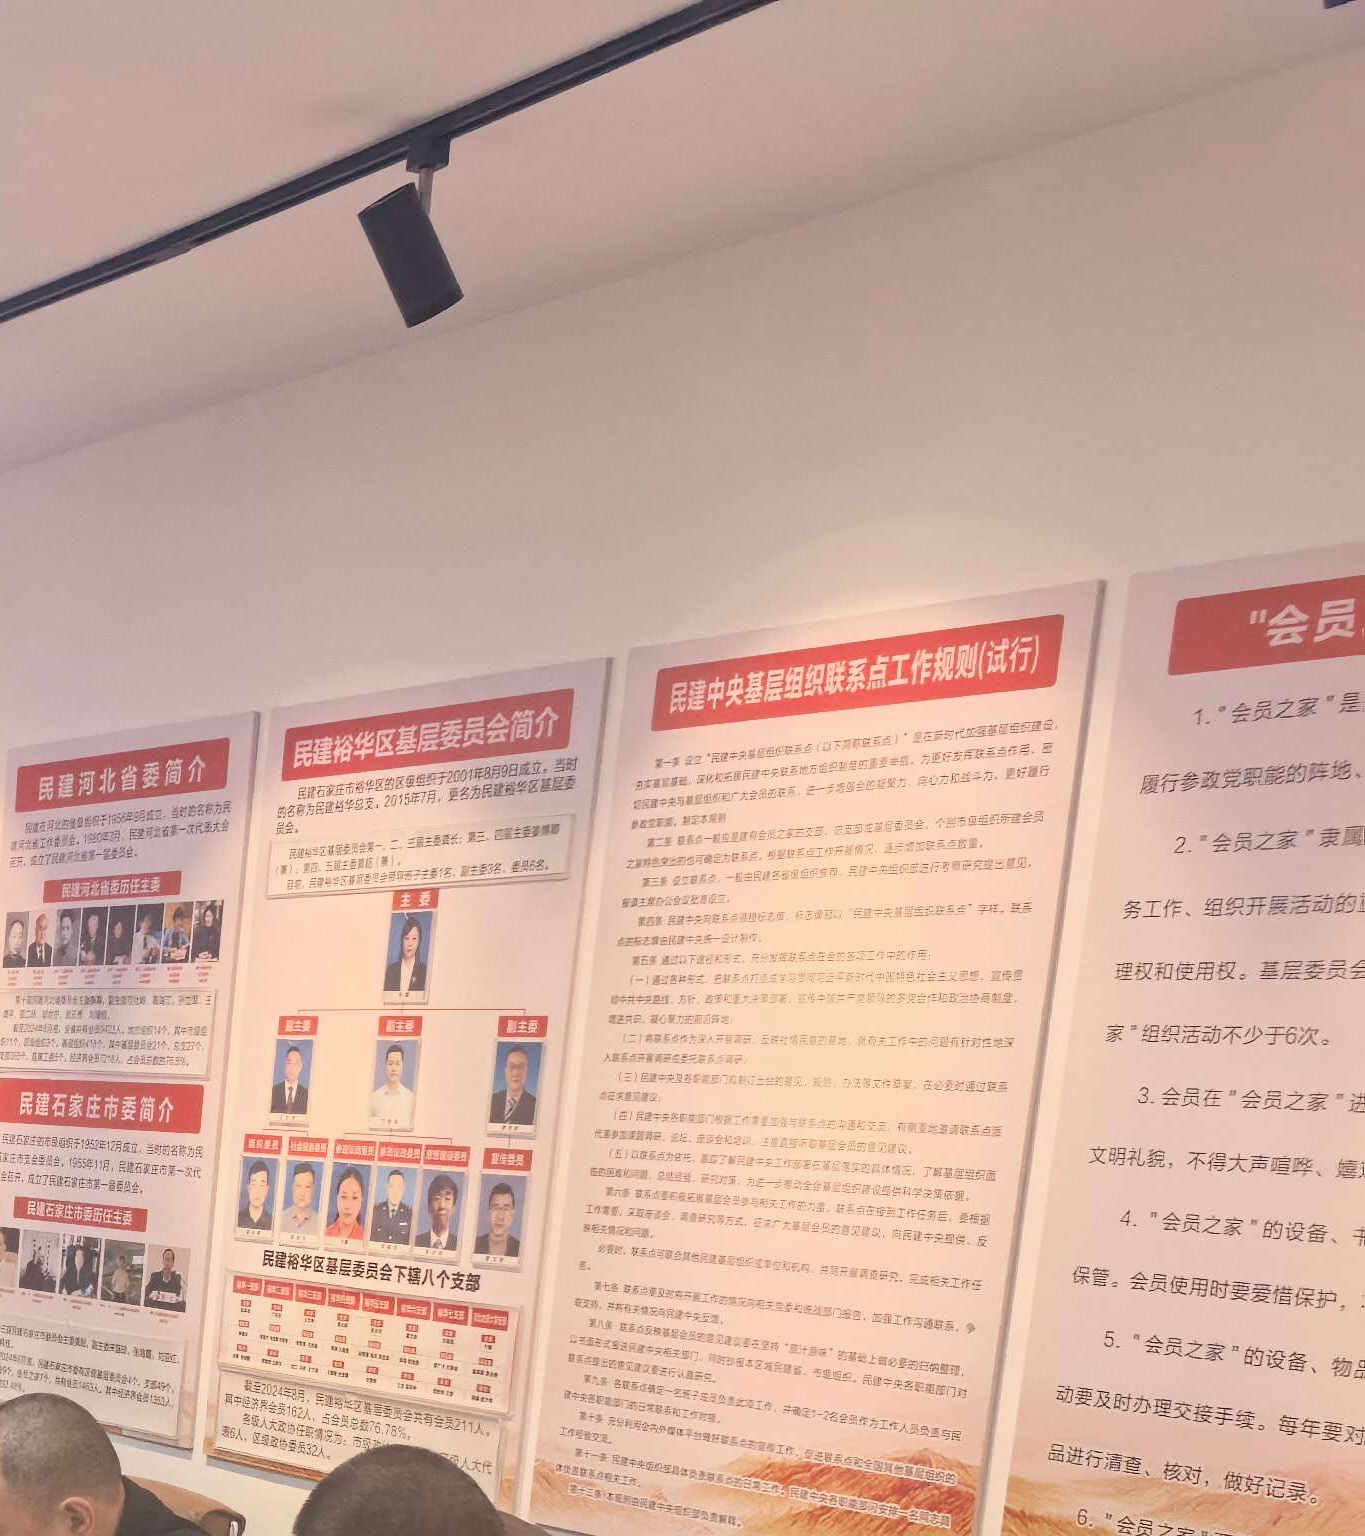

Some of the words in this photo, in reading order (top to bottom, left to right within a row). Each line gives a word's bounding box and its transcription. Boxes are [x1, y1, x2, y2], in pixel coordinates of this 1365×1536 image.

[669, 635, 1041, 714] 民建中央基层组织联系点工作规则(试行)
[1195, 692, 1365, 725] 1.“会员之家”是
[293, 706, 559, 768] 民建裕华区基层委员会简介
[38, 755, 207, 801] 民建河北省委简介
[1123, 894, 1365, 920] 务工作、组织开展活动的
[20, 1091, 174, 1123] 民建石家庄市委简介
[27, 1201, 132, 1226] 民建石家庄市委历任主委
[262, 1249, 482, 1292] 民建裕华区基层委员会下辖八个支部
[1072, 1265, 1365, 1311] 保管。会员使用时要爱惜保护，
